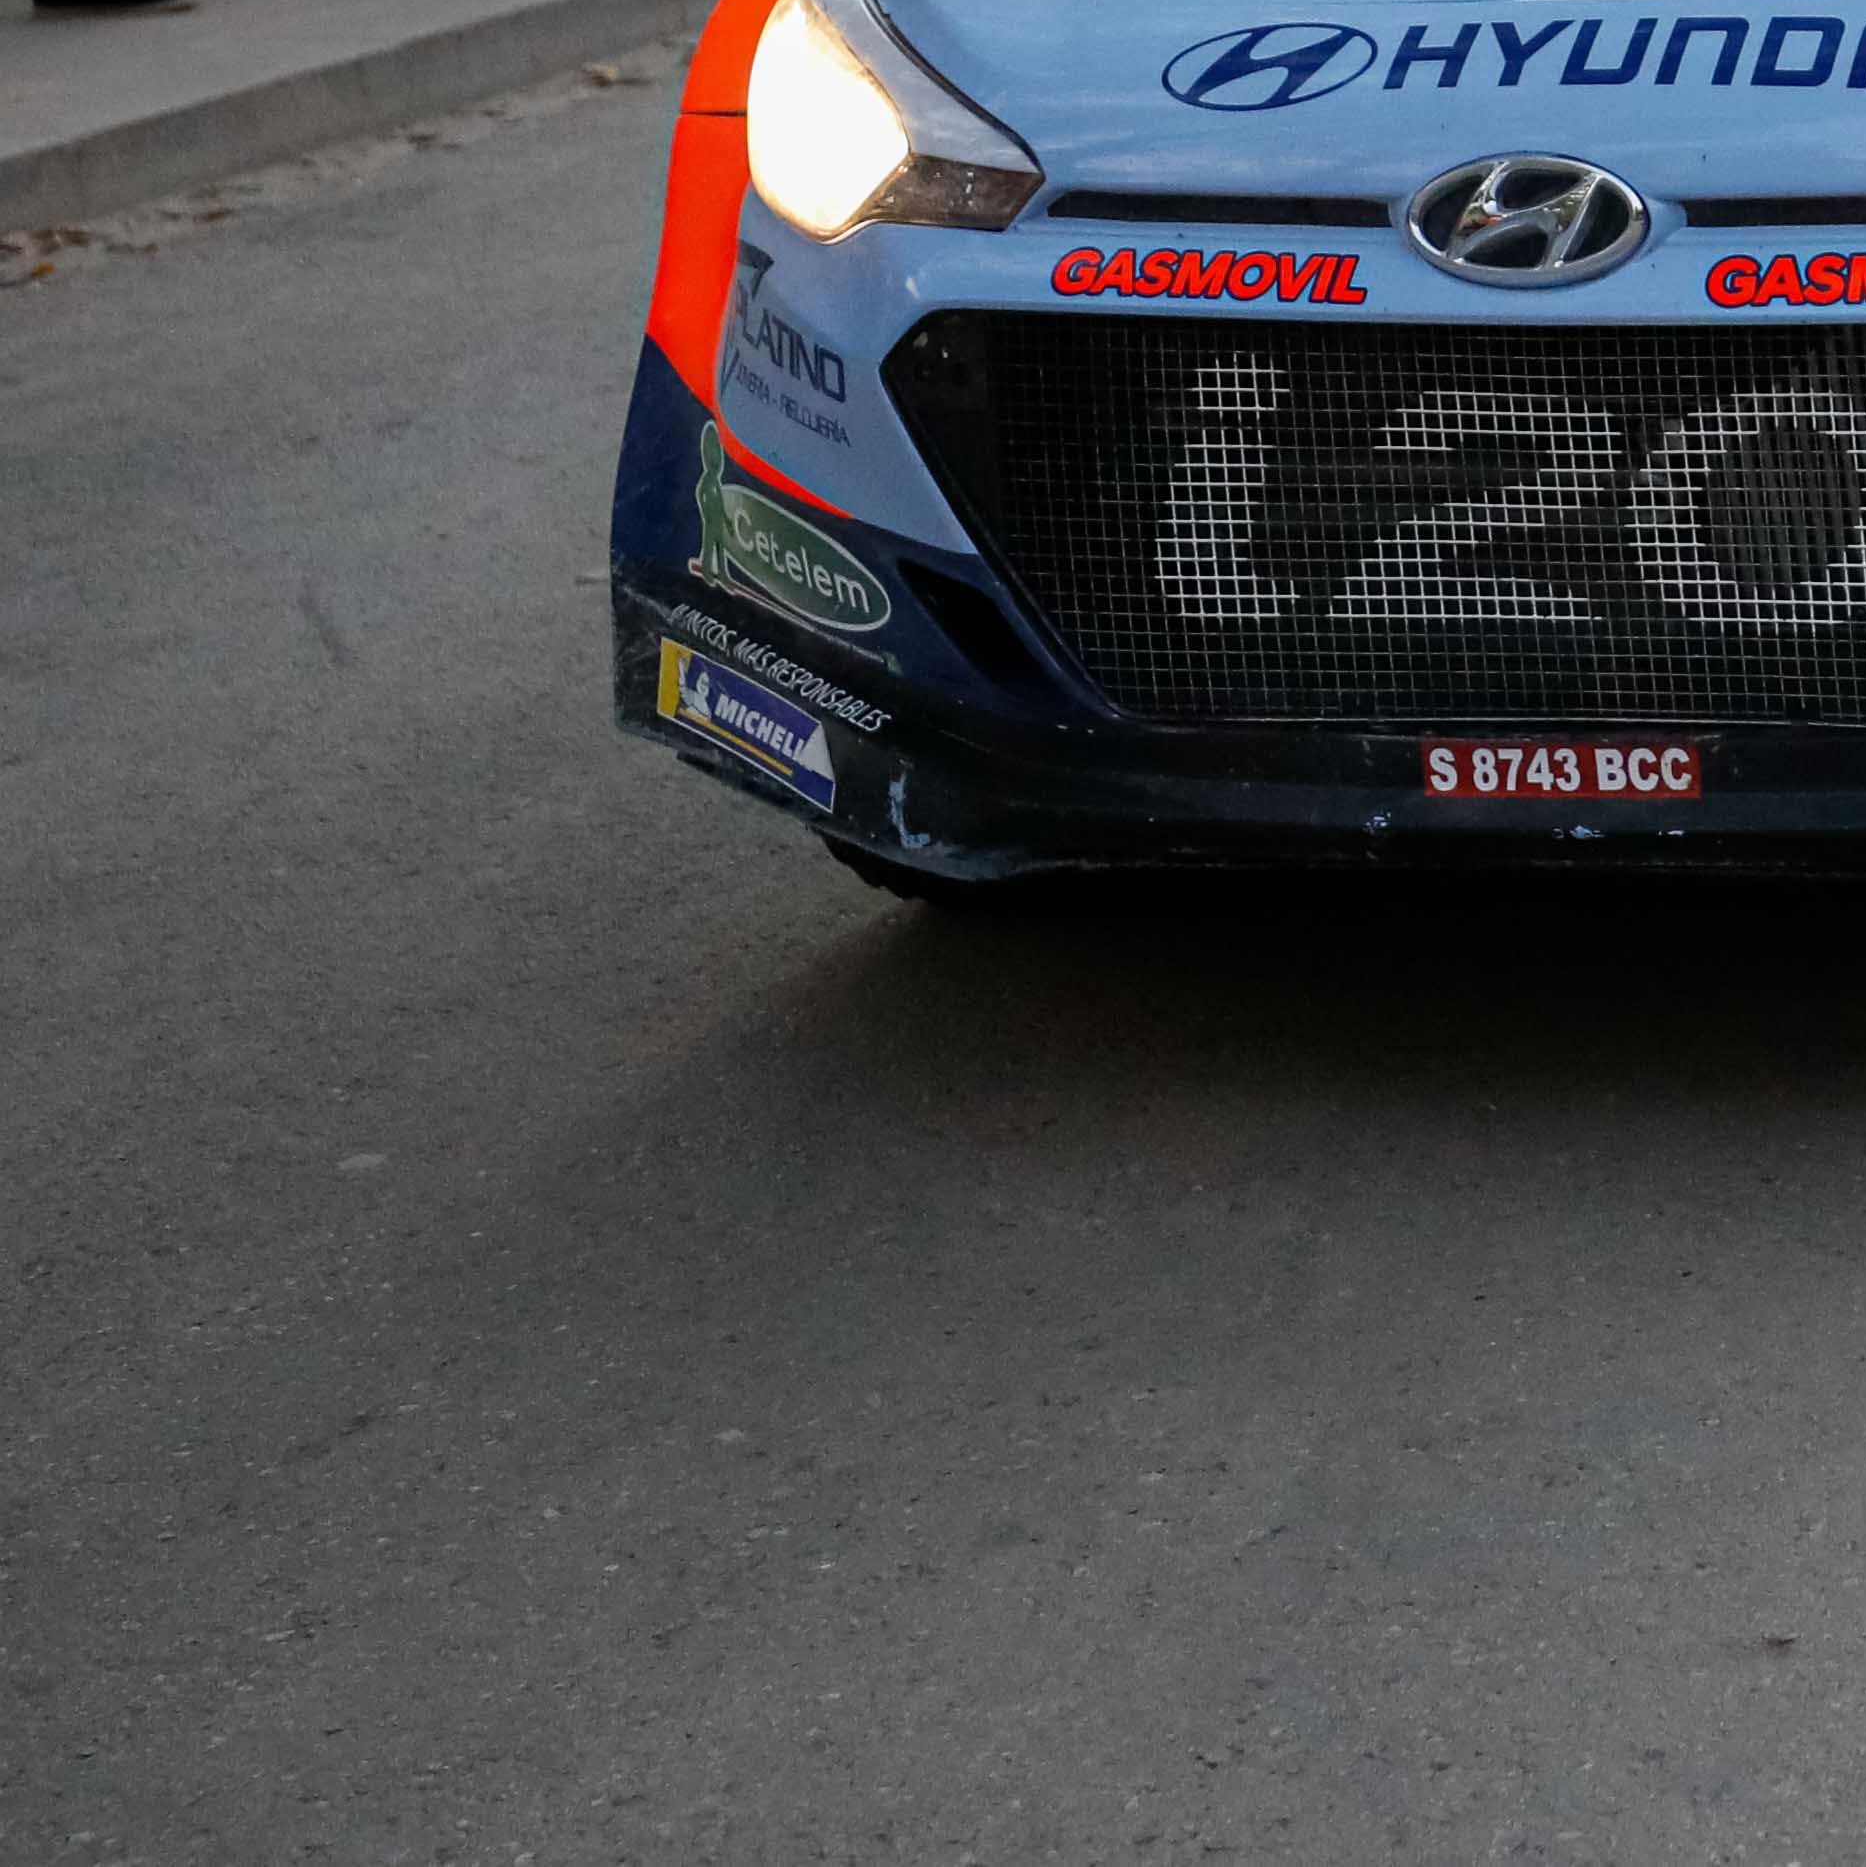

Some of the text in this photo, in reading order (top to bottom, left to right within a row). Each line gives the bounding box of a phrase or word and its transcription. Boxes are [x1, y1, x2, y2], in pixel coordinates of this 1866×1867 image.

[1052, 248, 1367, 306] GASMOVIL
[733, 511, 871, 615] Cetelem
[732, 637, 776, 673] MÁS
[766, 657, 892, 732] RESPONSABLES
[714, 693, 808, 765] MICHELI
[1430, 747, 1695, 792] S 8743 BCC
